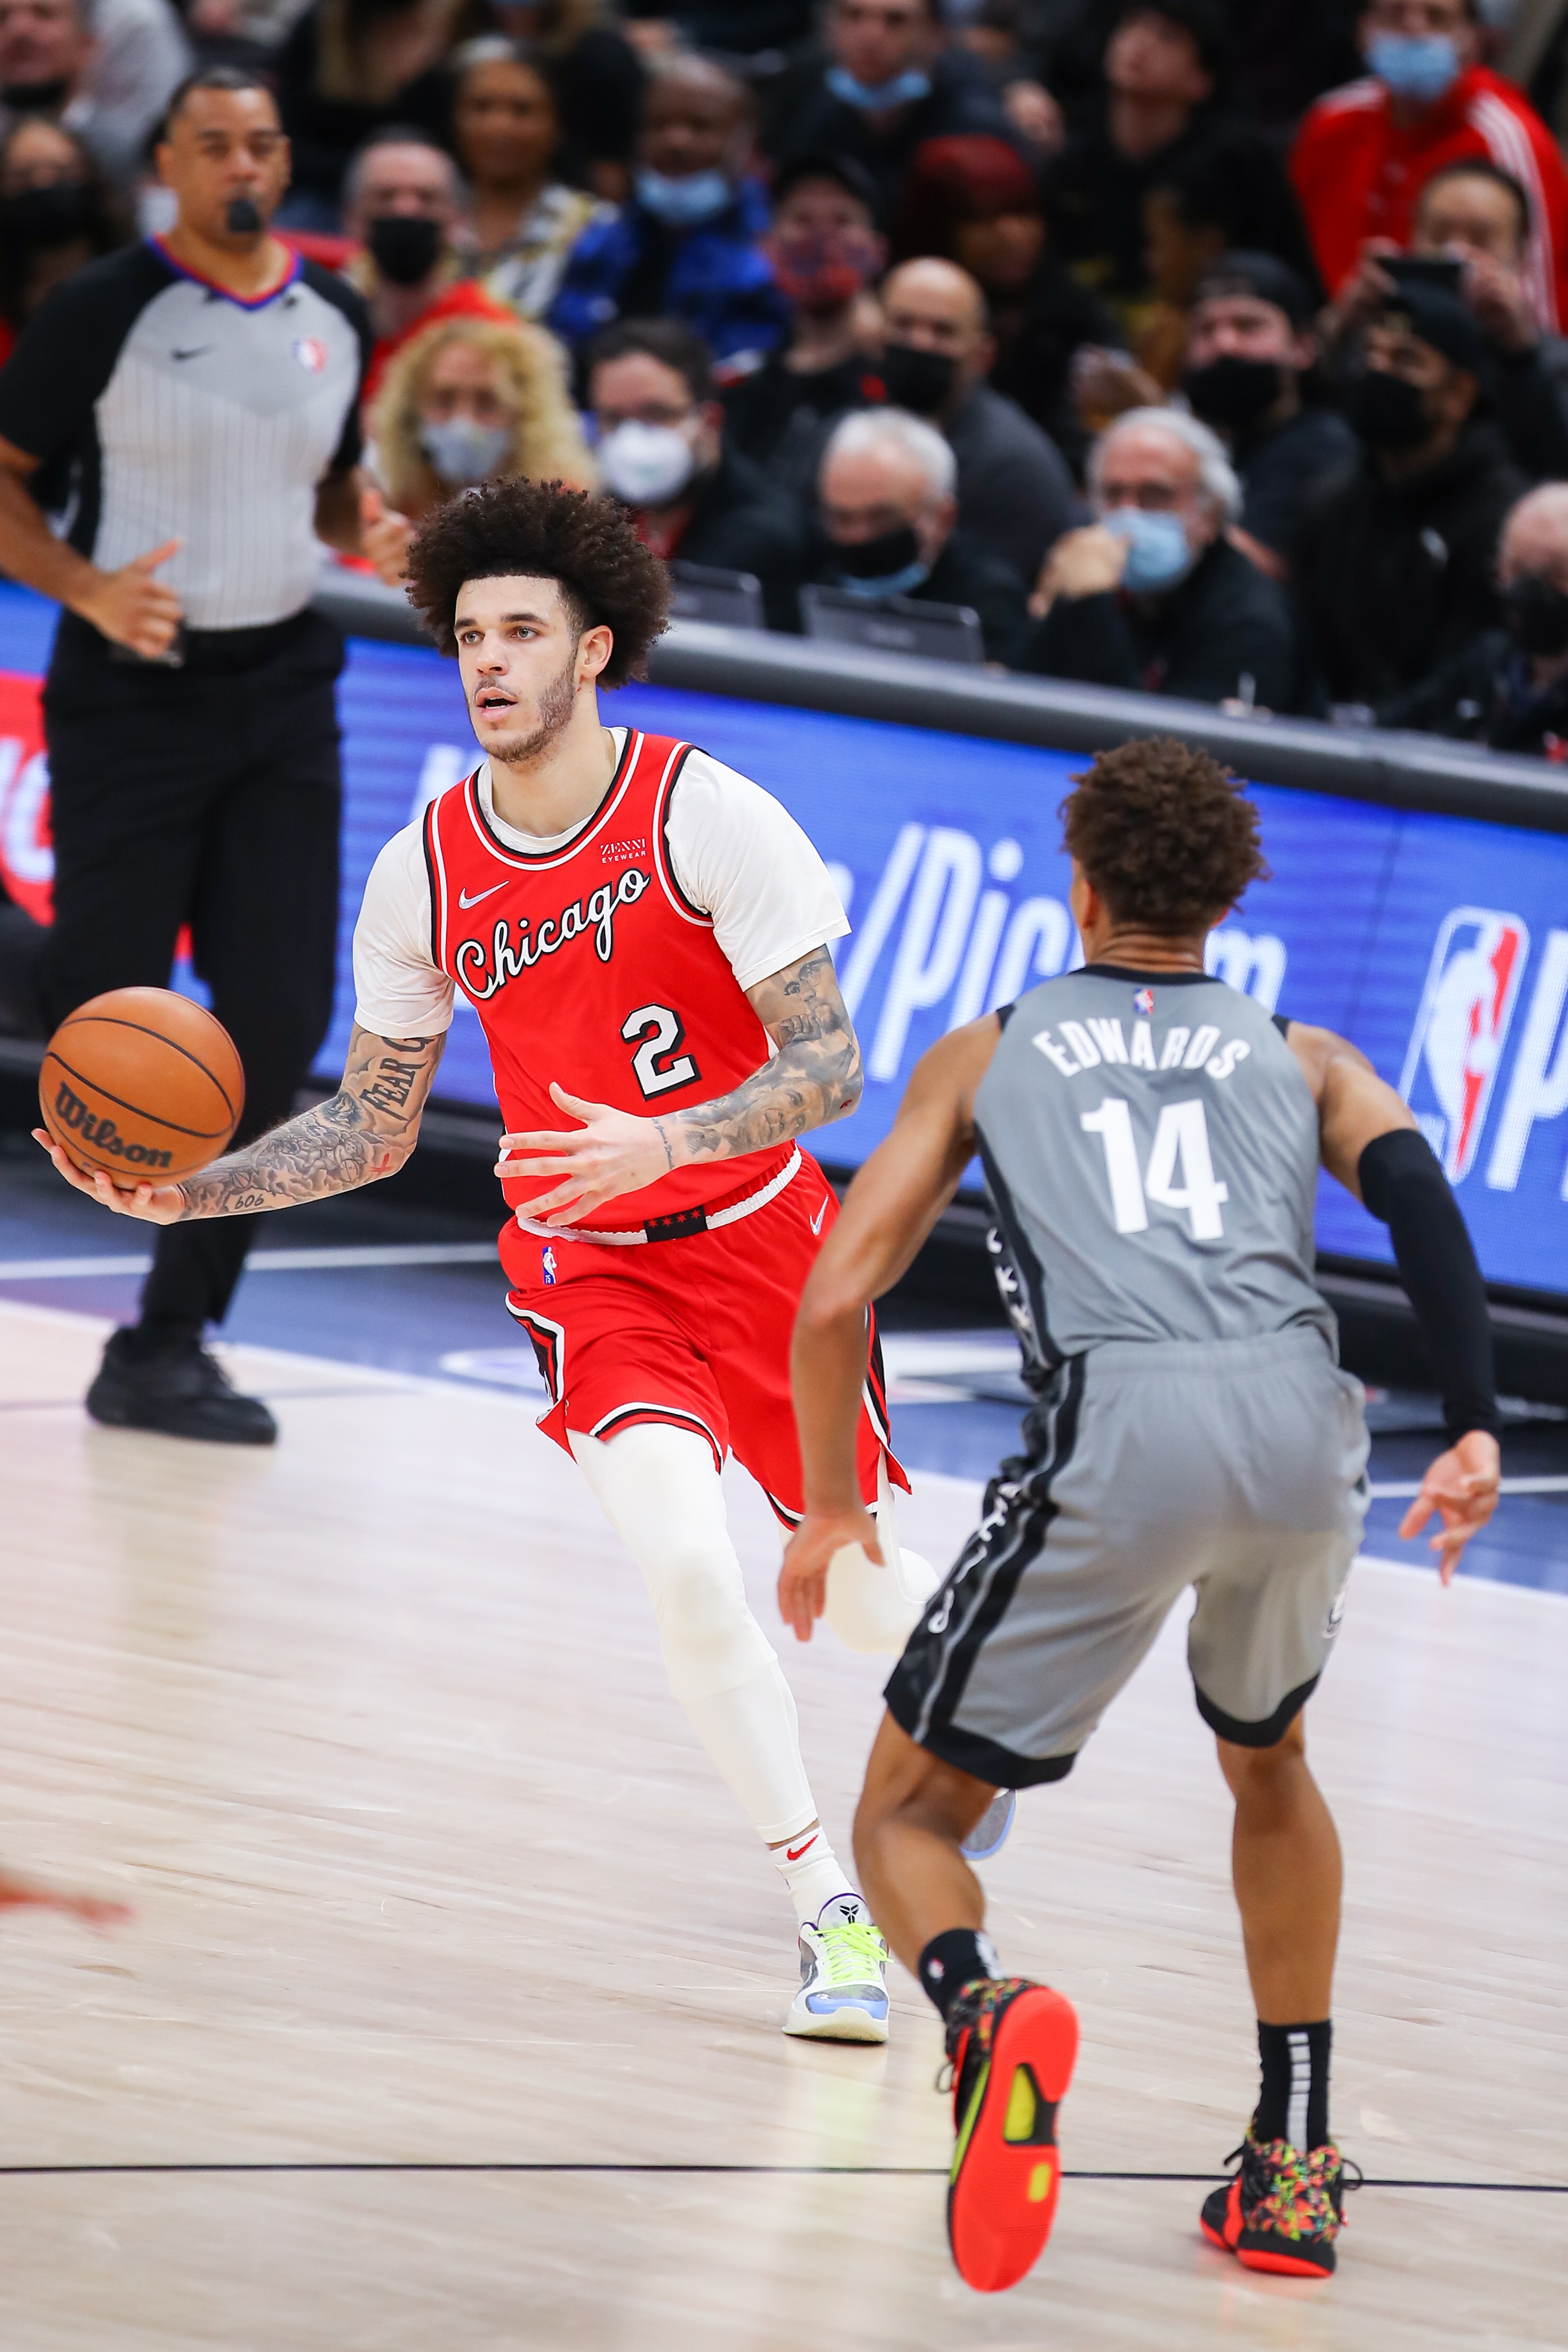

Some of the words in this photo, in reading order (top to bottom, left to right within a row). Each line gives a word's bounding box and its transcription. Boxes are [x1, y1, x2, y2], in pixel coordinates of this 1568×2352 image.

[600, 838, 645, 855] ZENNI
[602, 850, 646, 864] EYEWEAR
[455, 868, 652, 1000] Chicago
[619, 1002, 701, 1101] 2
[1031, 1017, 1251, 1080] EDWARDS
[55, 1079, 173, 1168] Wilson
[359, 1057, 429, 1121] FEAR
[1080, 1097, 1229, 1241] 14
